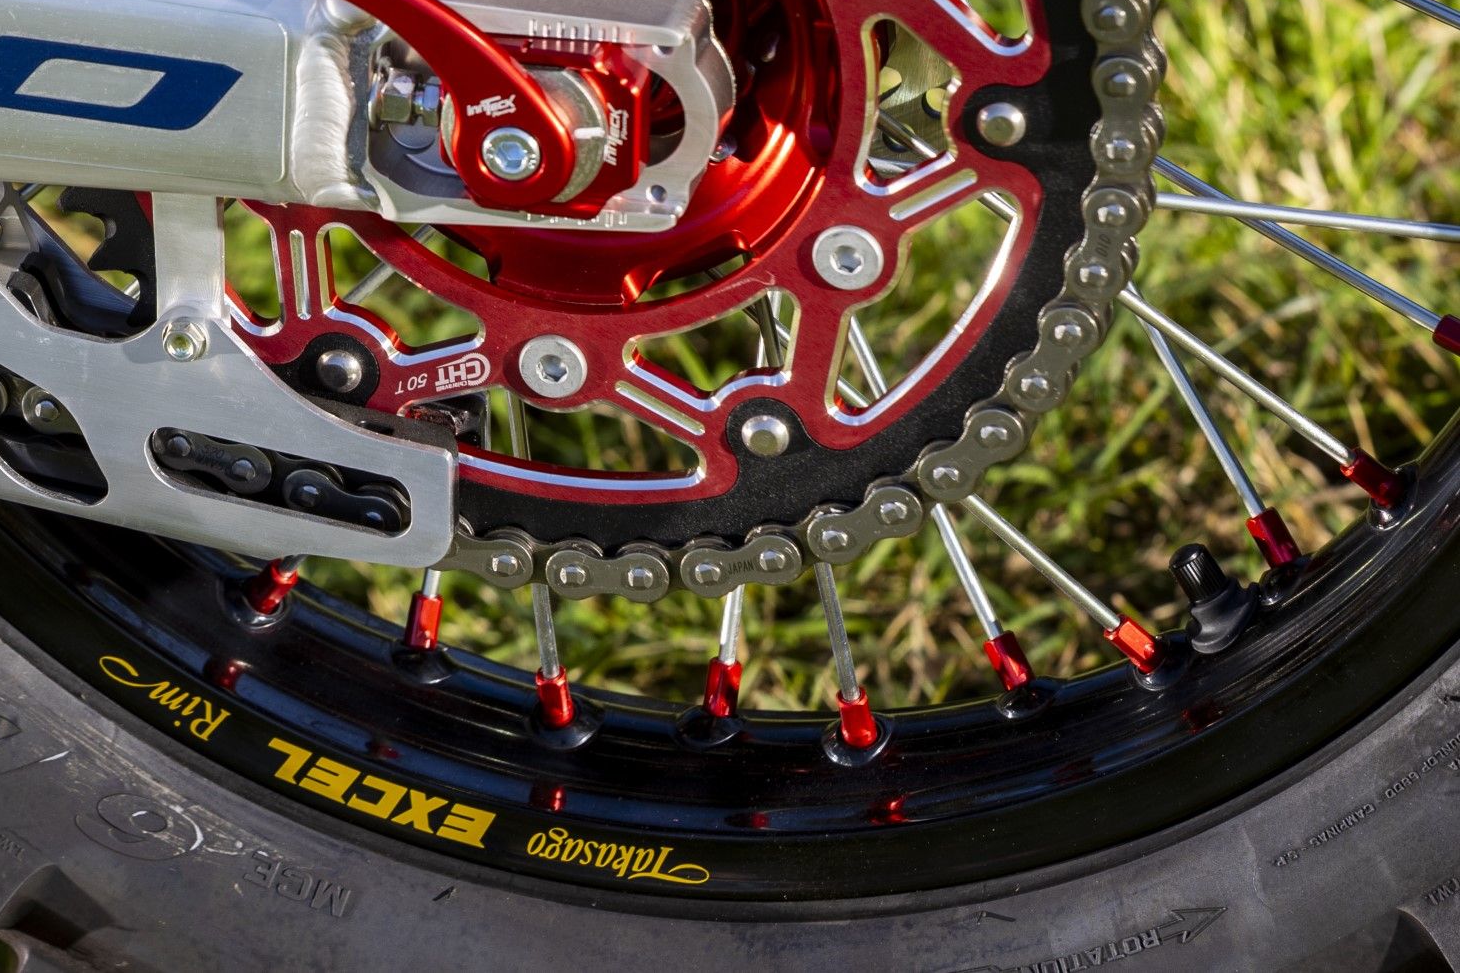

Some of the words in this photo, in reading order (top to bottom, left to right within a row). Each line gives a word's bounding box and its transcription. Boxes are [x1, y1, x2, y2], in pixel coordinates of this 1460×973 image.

[435, 360, 482, 386] CHT
[728, 559, 754, 577] JAPAN
[99, 655, 232, 742] Rim
[268, 738, 496, 849] EXCEL
[242, 850, 352, 918] MCE
[527, 828, 710, 885] Takasago
